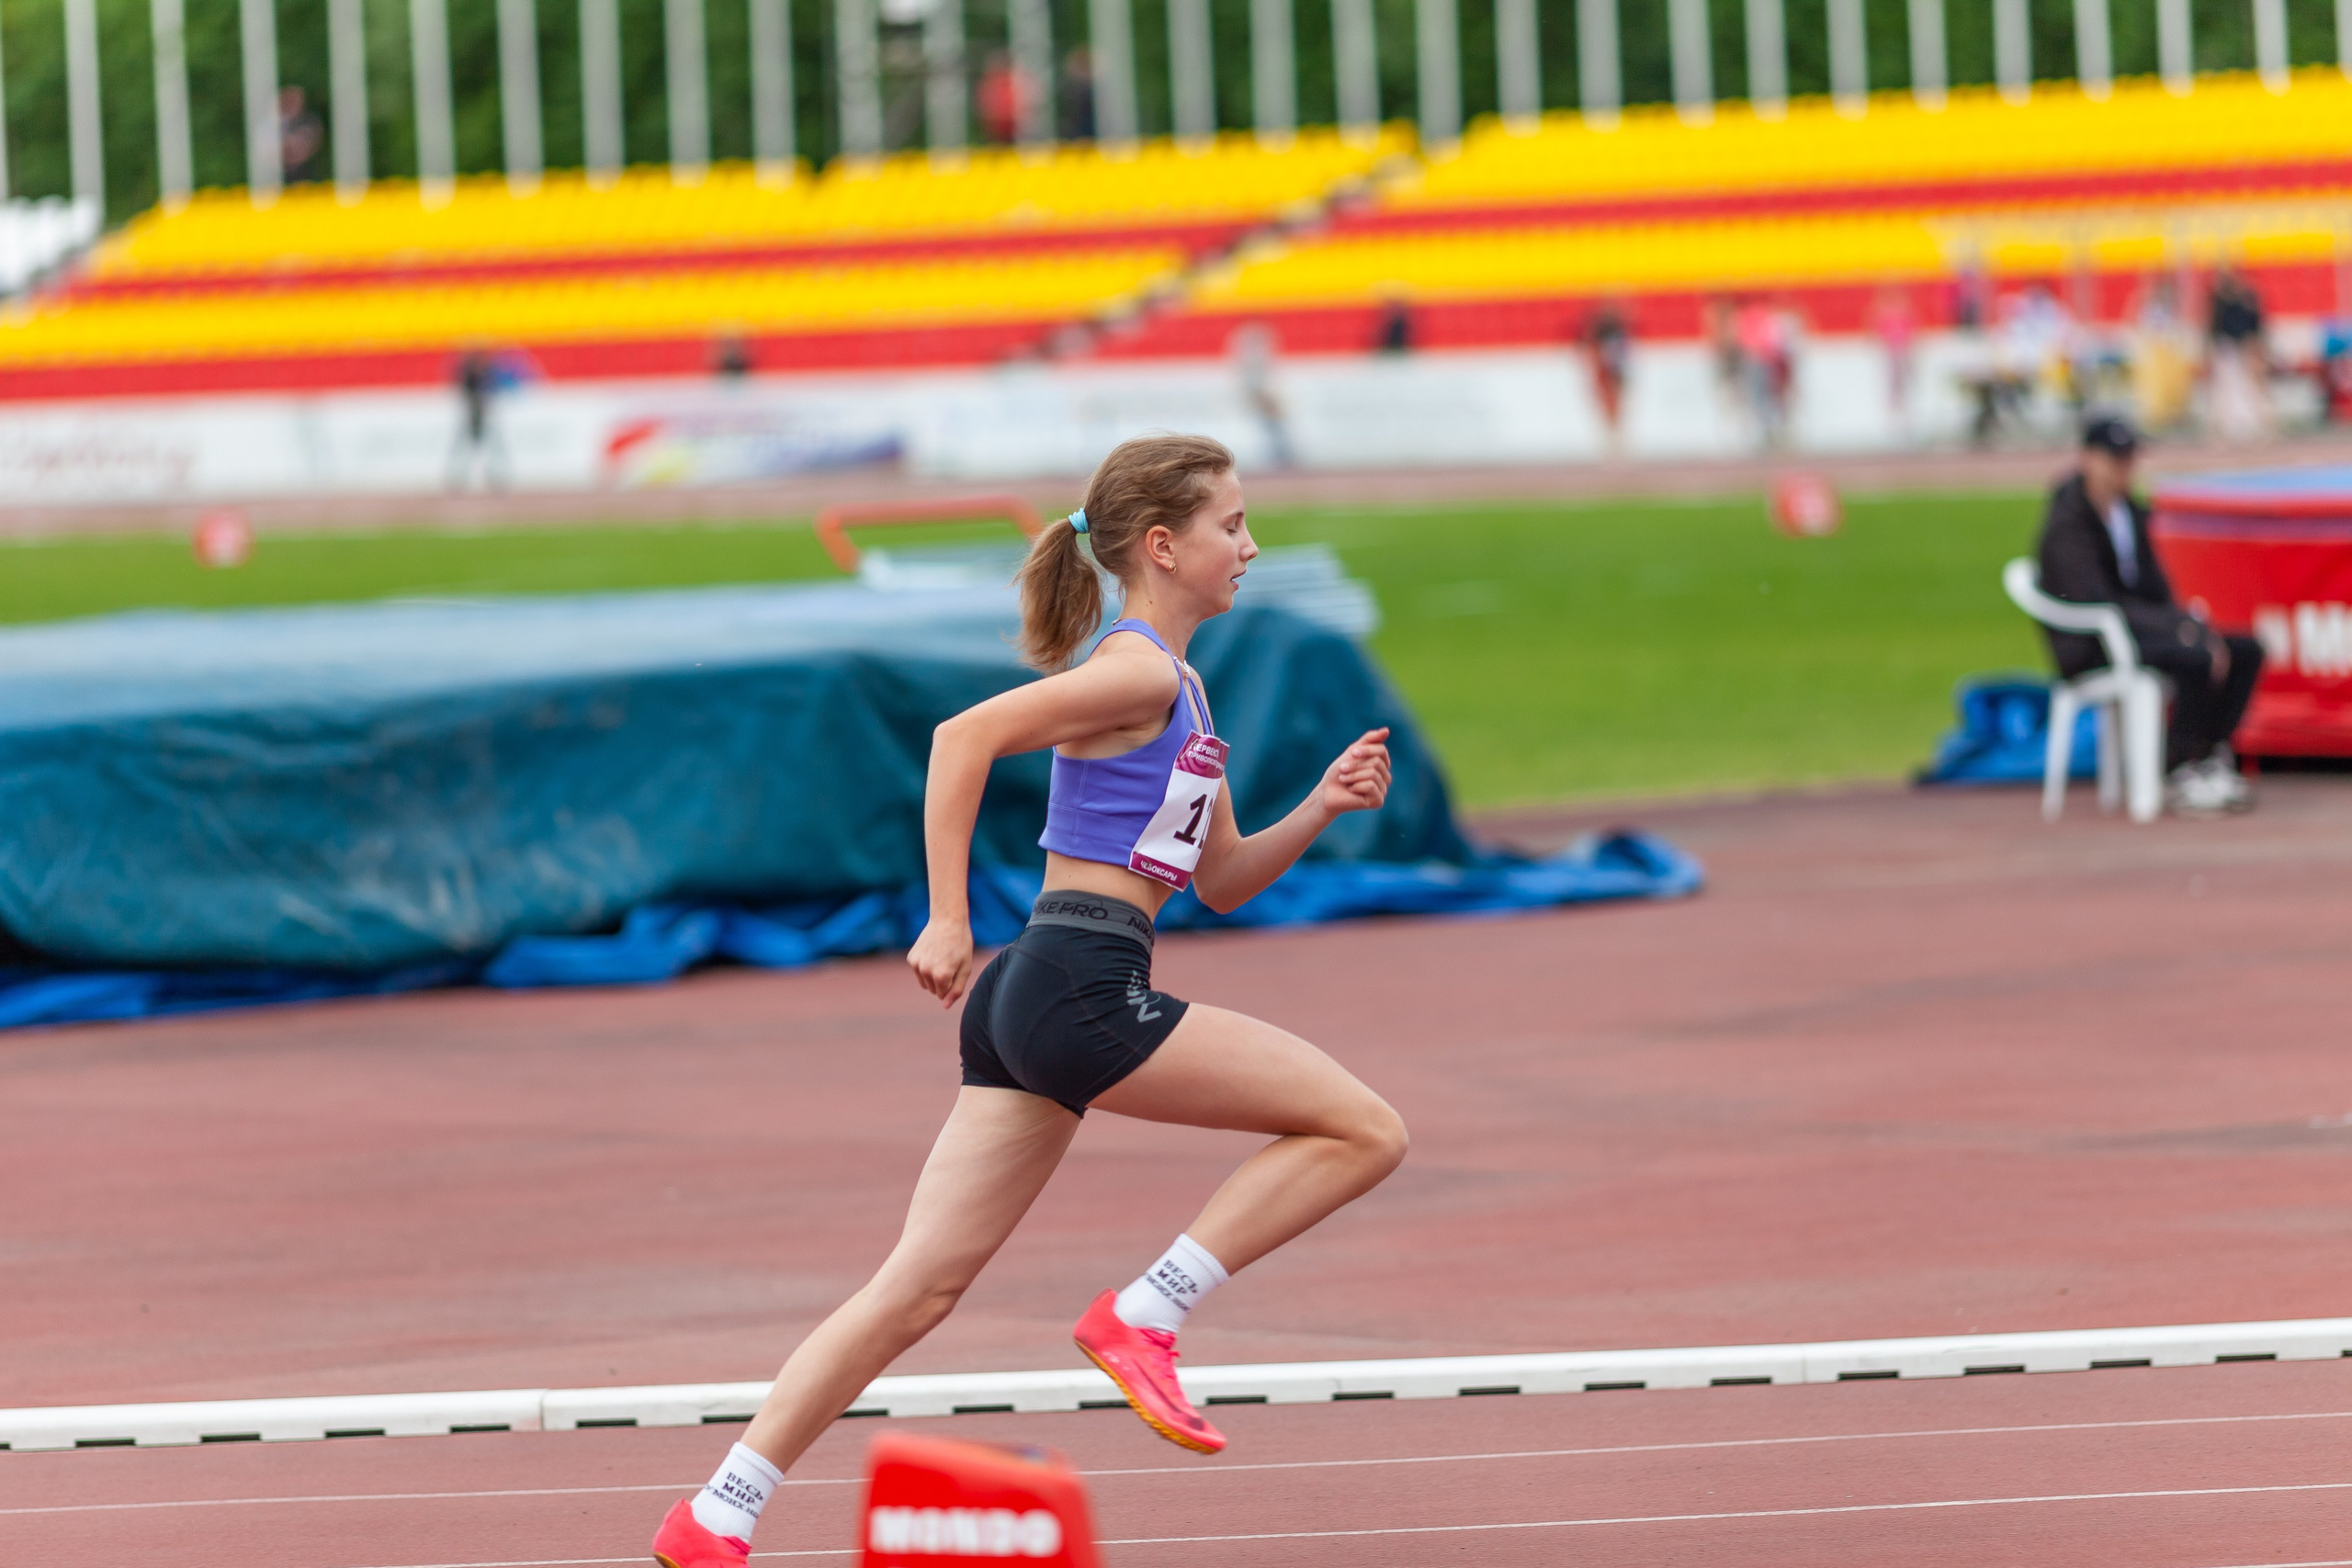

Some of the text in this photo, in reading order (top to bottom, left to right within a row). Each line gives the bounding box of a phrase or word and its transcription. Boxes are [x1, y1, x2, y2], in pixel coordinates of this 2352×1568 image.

[1140, 860, 1178, 882] ЧЕБОКСАРЫ
[1162, 1259, 1199, 1294] ВЕСЬ
[727, 1472, 763, 1500] ВЕСЬ
[871, 1505, 1062, 1558] MONDO
